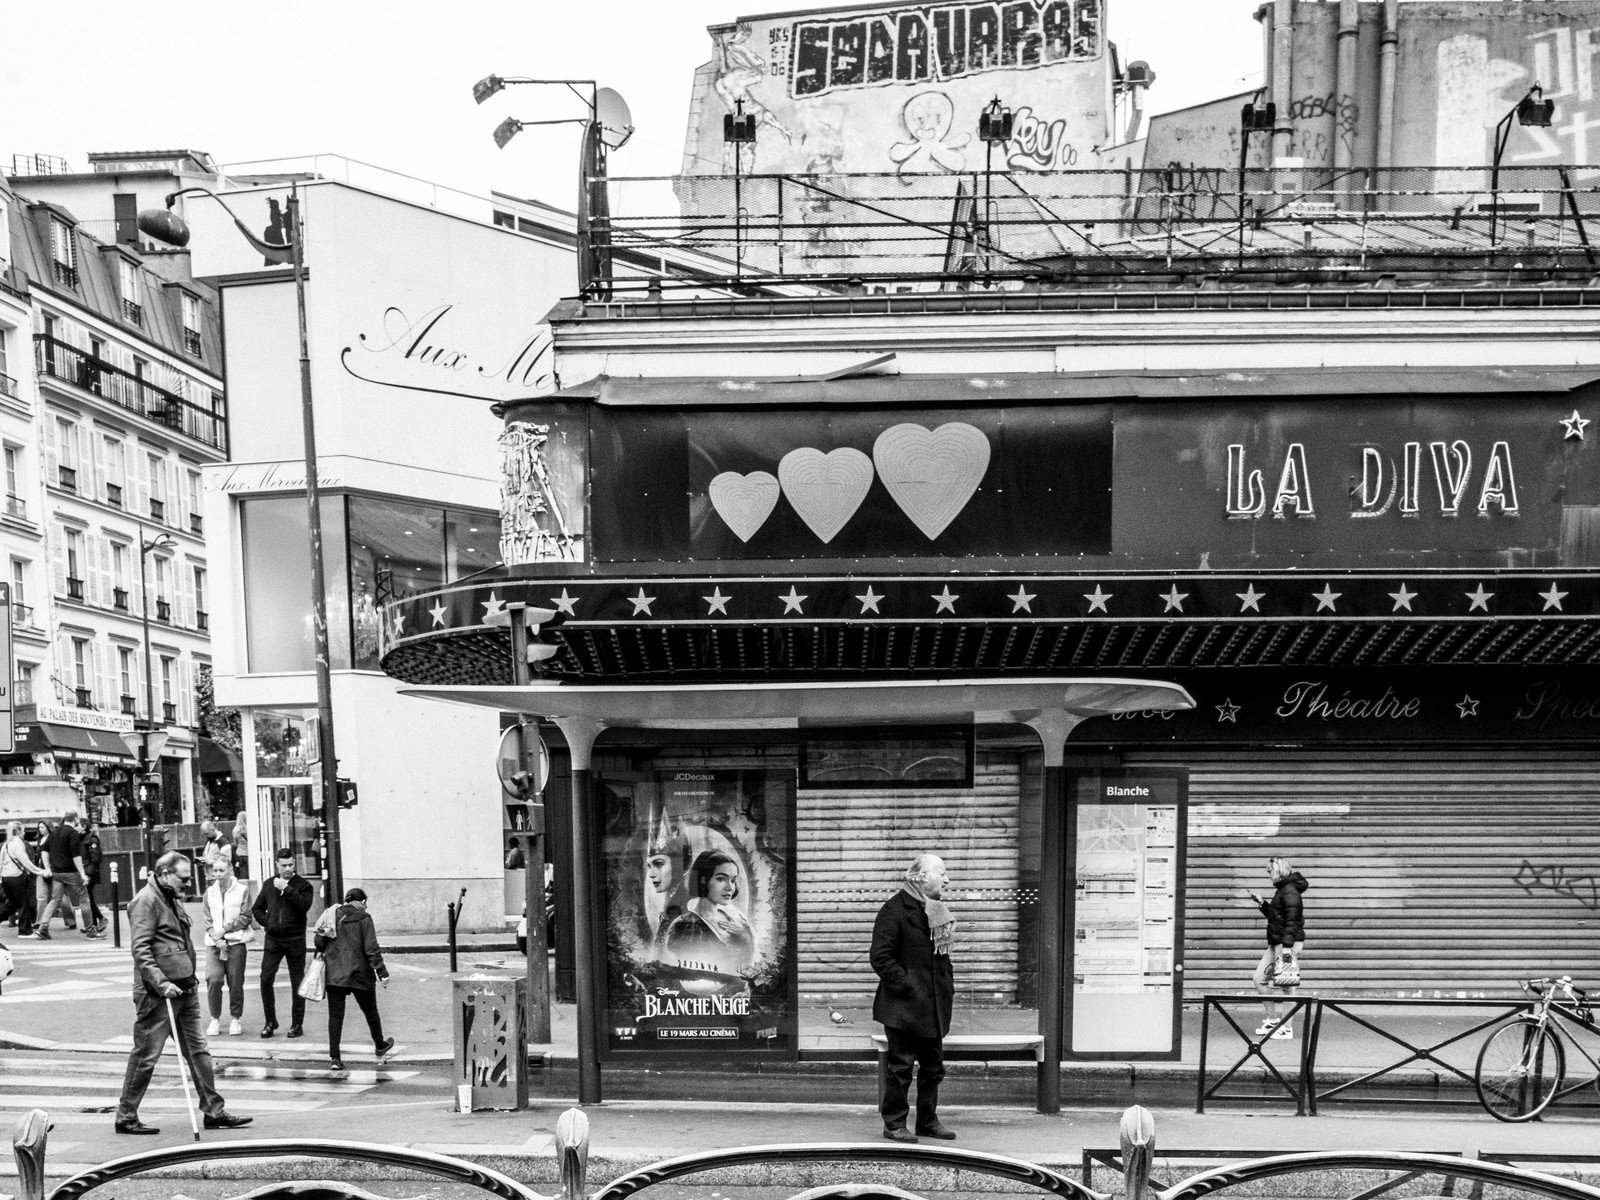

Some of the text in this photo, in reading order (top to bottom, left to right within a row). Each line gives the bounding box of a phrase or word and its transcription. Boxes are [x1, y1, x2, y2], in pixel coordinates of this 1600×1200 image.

[359, 304, 556, 390] Aux Me
[204, 465, 247, 492] Aux
[1226, 440, 1520, 519] LA DIVA
[49, 708, 67, 722] PALAIS
[68, 711, 79, 723] DES
[673, 773, 716, 781] JCDecaux
[1106, 786, 1150, 796] Blanche
[656, 986, 680, 997] Disney
[636, 995, 750, 1022] BLANCHE NEIGE
[615, 1027, 637, 1036] TF1
[660, 1028, 736, 1037] LE 19 MARS AU CINÉMA
[756, 1026, 778, 1039] FUN
